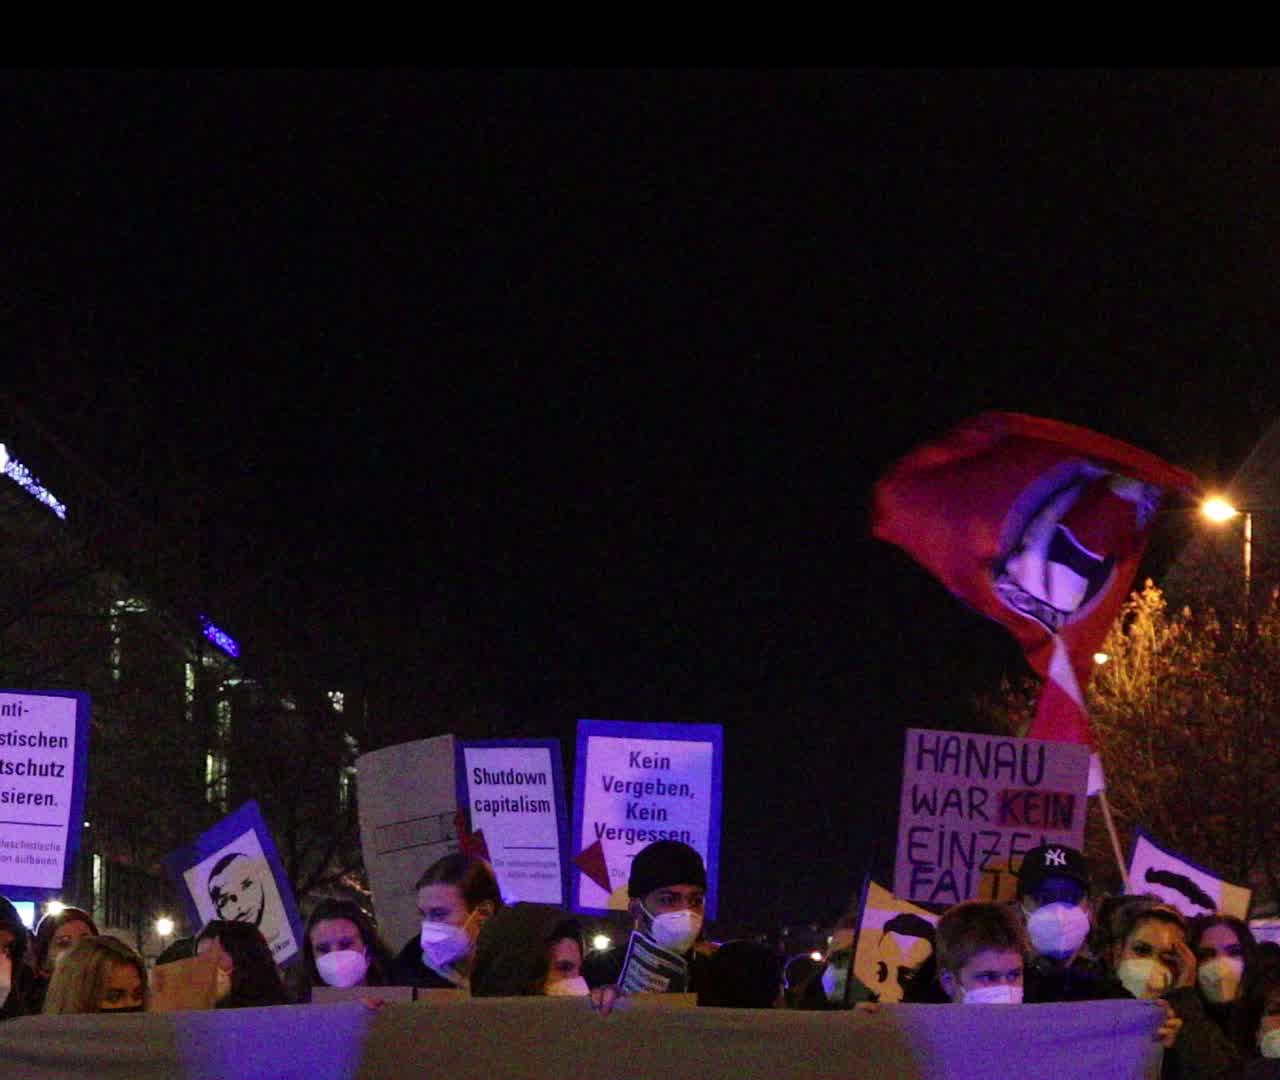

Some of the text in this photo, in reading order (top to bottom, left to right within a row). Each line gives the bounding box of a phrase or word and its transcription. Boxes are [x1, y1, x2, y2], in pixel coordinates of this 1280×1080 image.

[628, 751, 671, 770] Kein
[916, 734, 1046, 786] HANAU
[473, 767, 547, 786] Shutdown
[601, 775, 696, 799] Vergeben,
[474, 795, 551, 818] capitalism
[625, 802, 668, 821] Kein
[912, 787, 1075, 830] WAR KEIN
[594, 822, 696, 844] Vergessen.
